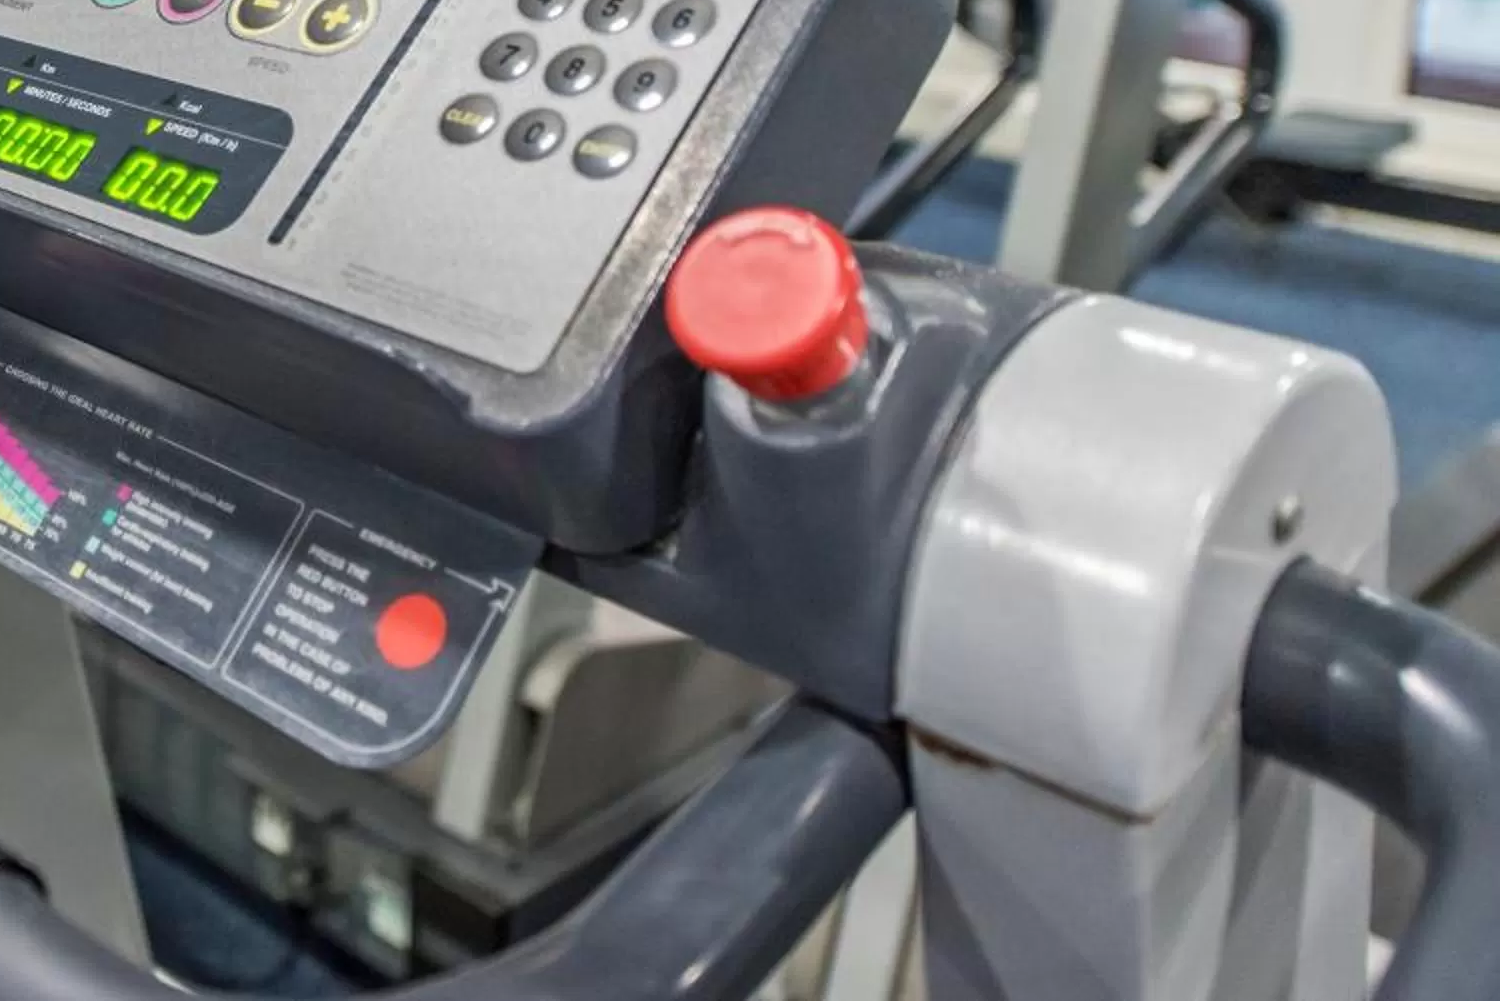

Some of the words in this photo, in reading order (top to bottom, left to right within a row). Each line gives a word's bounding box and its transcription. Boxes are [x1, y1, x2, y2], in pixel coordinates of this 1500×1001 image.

[673, 7, 695, 29] 6
[500, 44, 522, 65] 7
[564, 57, 584, 79] 8
[633, 72, 655, 93] 9
[164, 122, 199, 139] SPEED
[524, 122, 545, 146] 0
